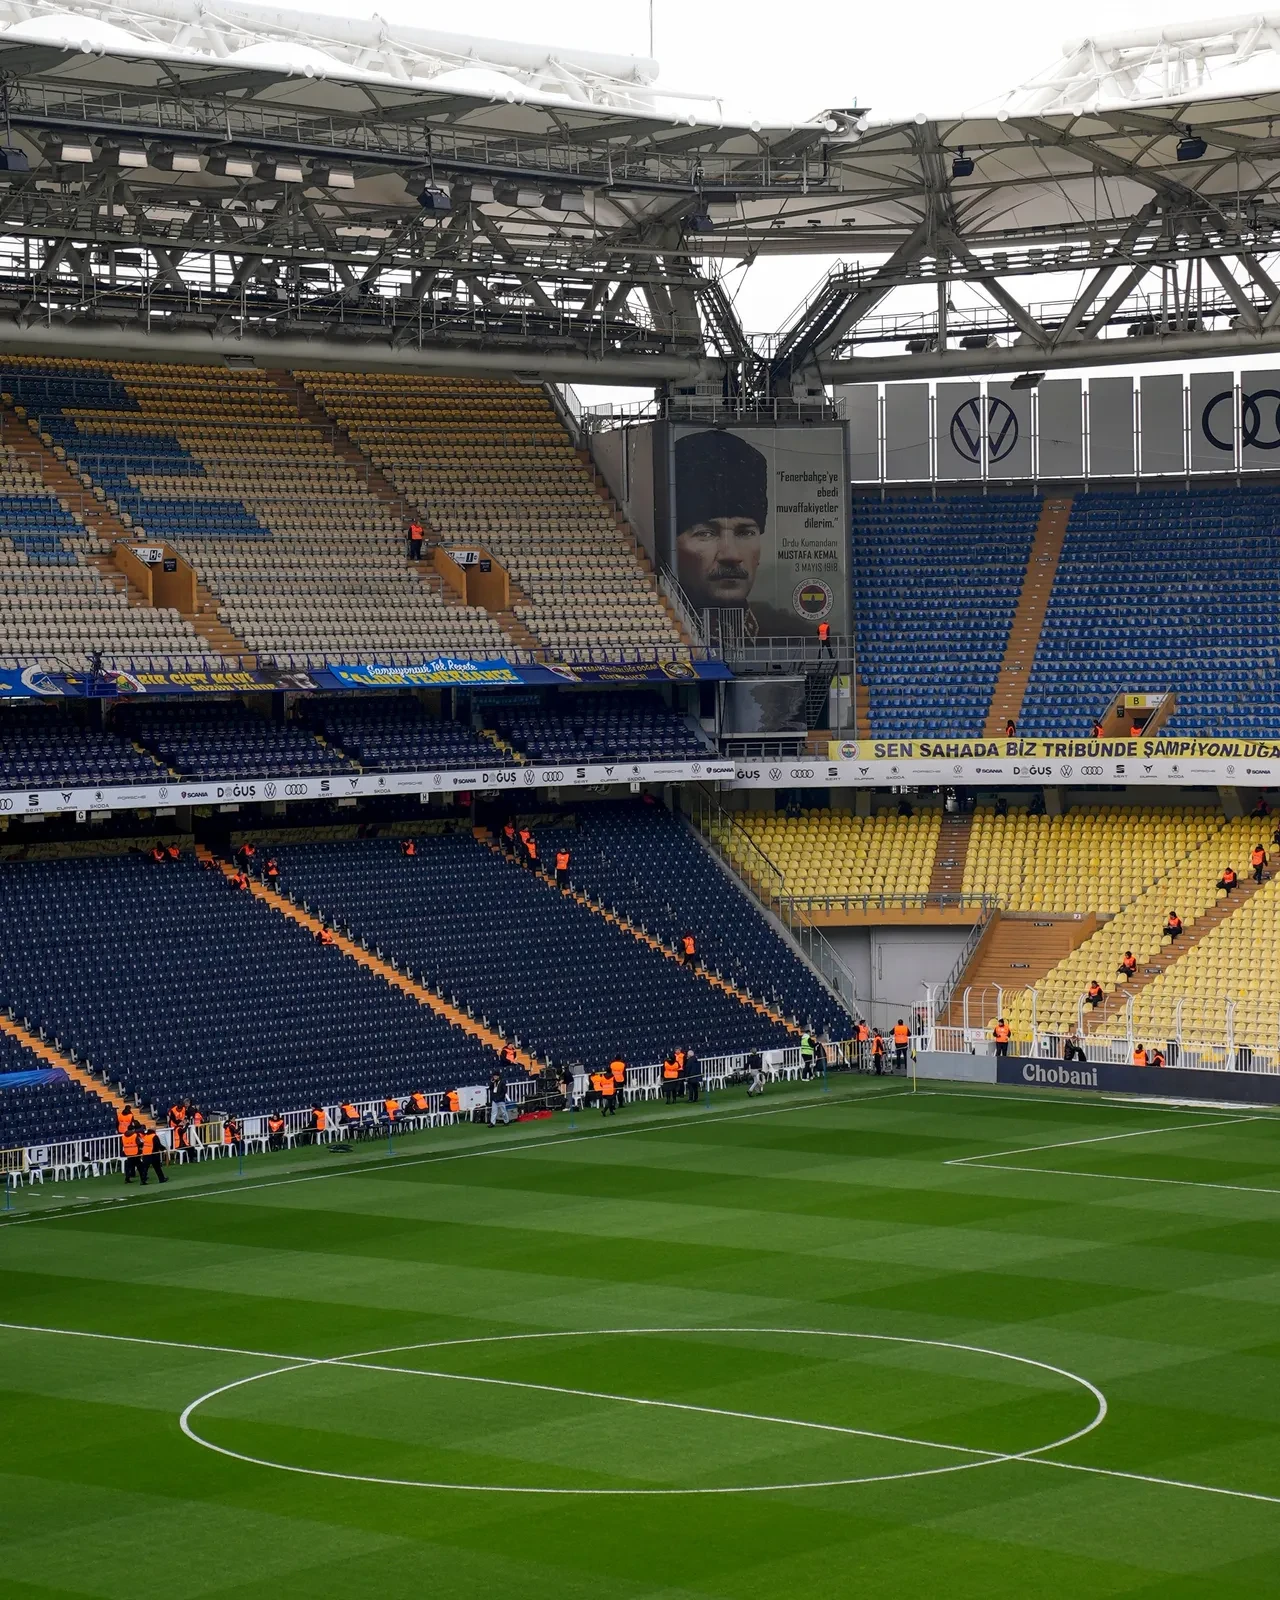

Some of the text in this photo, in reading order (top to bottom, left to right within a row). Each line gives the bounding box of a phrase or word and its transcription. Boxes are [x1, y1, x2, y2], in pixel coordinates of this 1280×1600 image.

[817, 486, 839, 498] ebedi
[776, 502, 839, 515] muvaffakiyetler
[782, 537, 838, 548] Ordu Kumandanı
[778, 550, 838, 560] MUSTAFA KEMAL
[795, 562, 838, 572] 3 MAYIS 1918
[136, 672, 169, 684] BİR
[1133, 697, 1140, 705] B
[874, 743, 913, 758] SEN
[920, 742, 999, 758] SAHADA
[1005, 739, 1037, 757] BİZ
[1042, 740, 1137, 757] TRİBÜNDE
[1143, 739, 1280, 759] ŞAMPİYONLUĞA
[737, 769, 761, 781] ĞUŞ
[78, 811, 84, 819] G
[735, 1057, 742, 1068] H
[1022, 1063, 1098, 1086] Chobani
[37, 1149, 43, 1162] F
